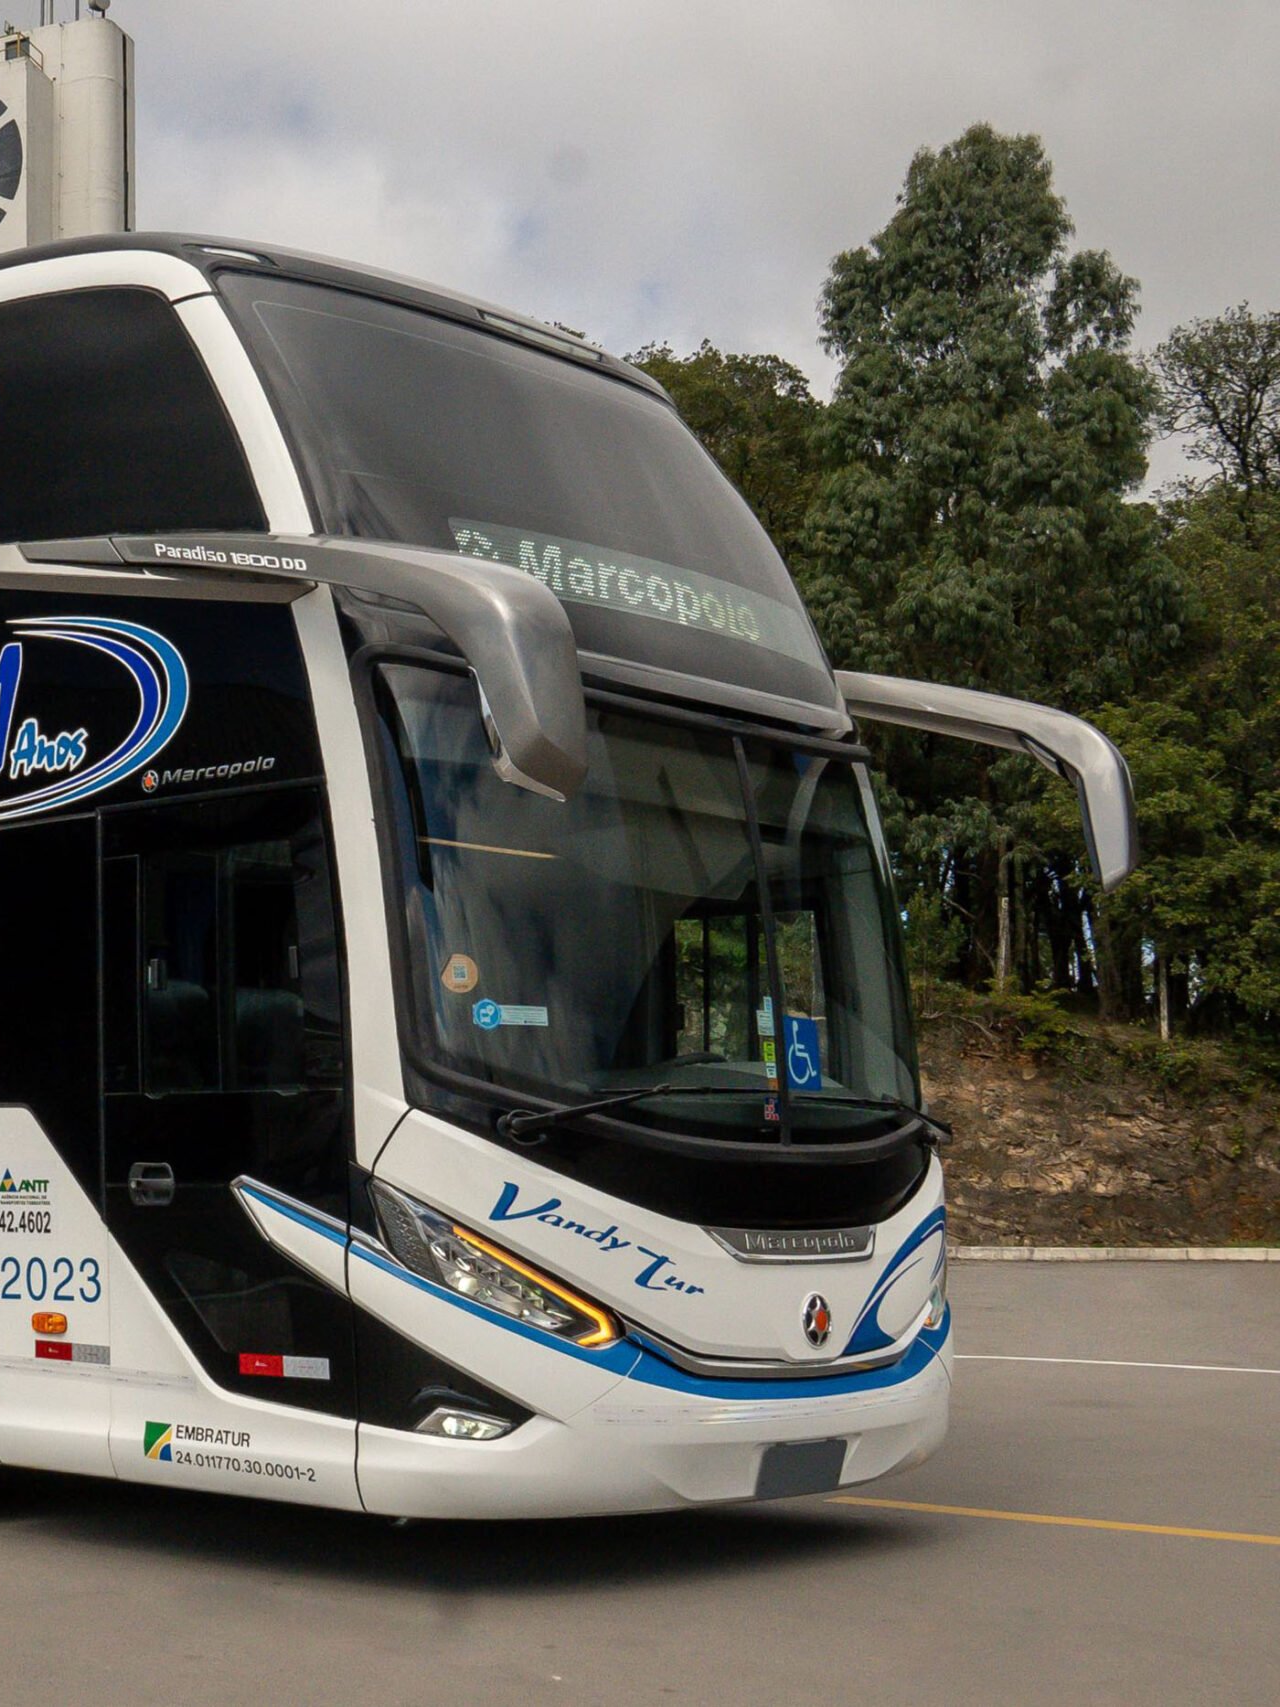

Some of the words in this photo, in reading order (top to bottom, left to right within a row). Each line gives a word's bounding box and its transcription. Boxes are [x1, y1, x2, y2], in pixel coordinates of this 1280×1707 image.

[154, 543, 227, 564] Paradiso
[231, 552, 280, 569] 1800
[282, 557, 308, 571] DD
[519, 540, 760, 642] Marcopolo
[10, 718, 88, 780] Anos
[161, 756, 276, 785] Marcopolo
[17, 1179, 50, 1193] ANTT
[488, 1181, 632, 1252] Vandy
[634, 1245, 705, 1295] Tur
[744, 1232, 855, 1253] Marcopolo
[0, 1256, 102, 1303] 2023
[175, 1424, 251, 1448] EMBRATUR
[175, 1450, 317, 1483] 24.011770.30.0001-2
